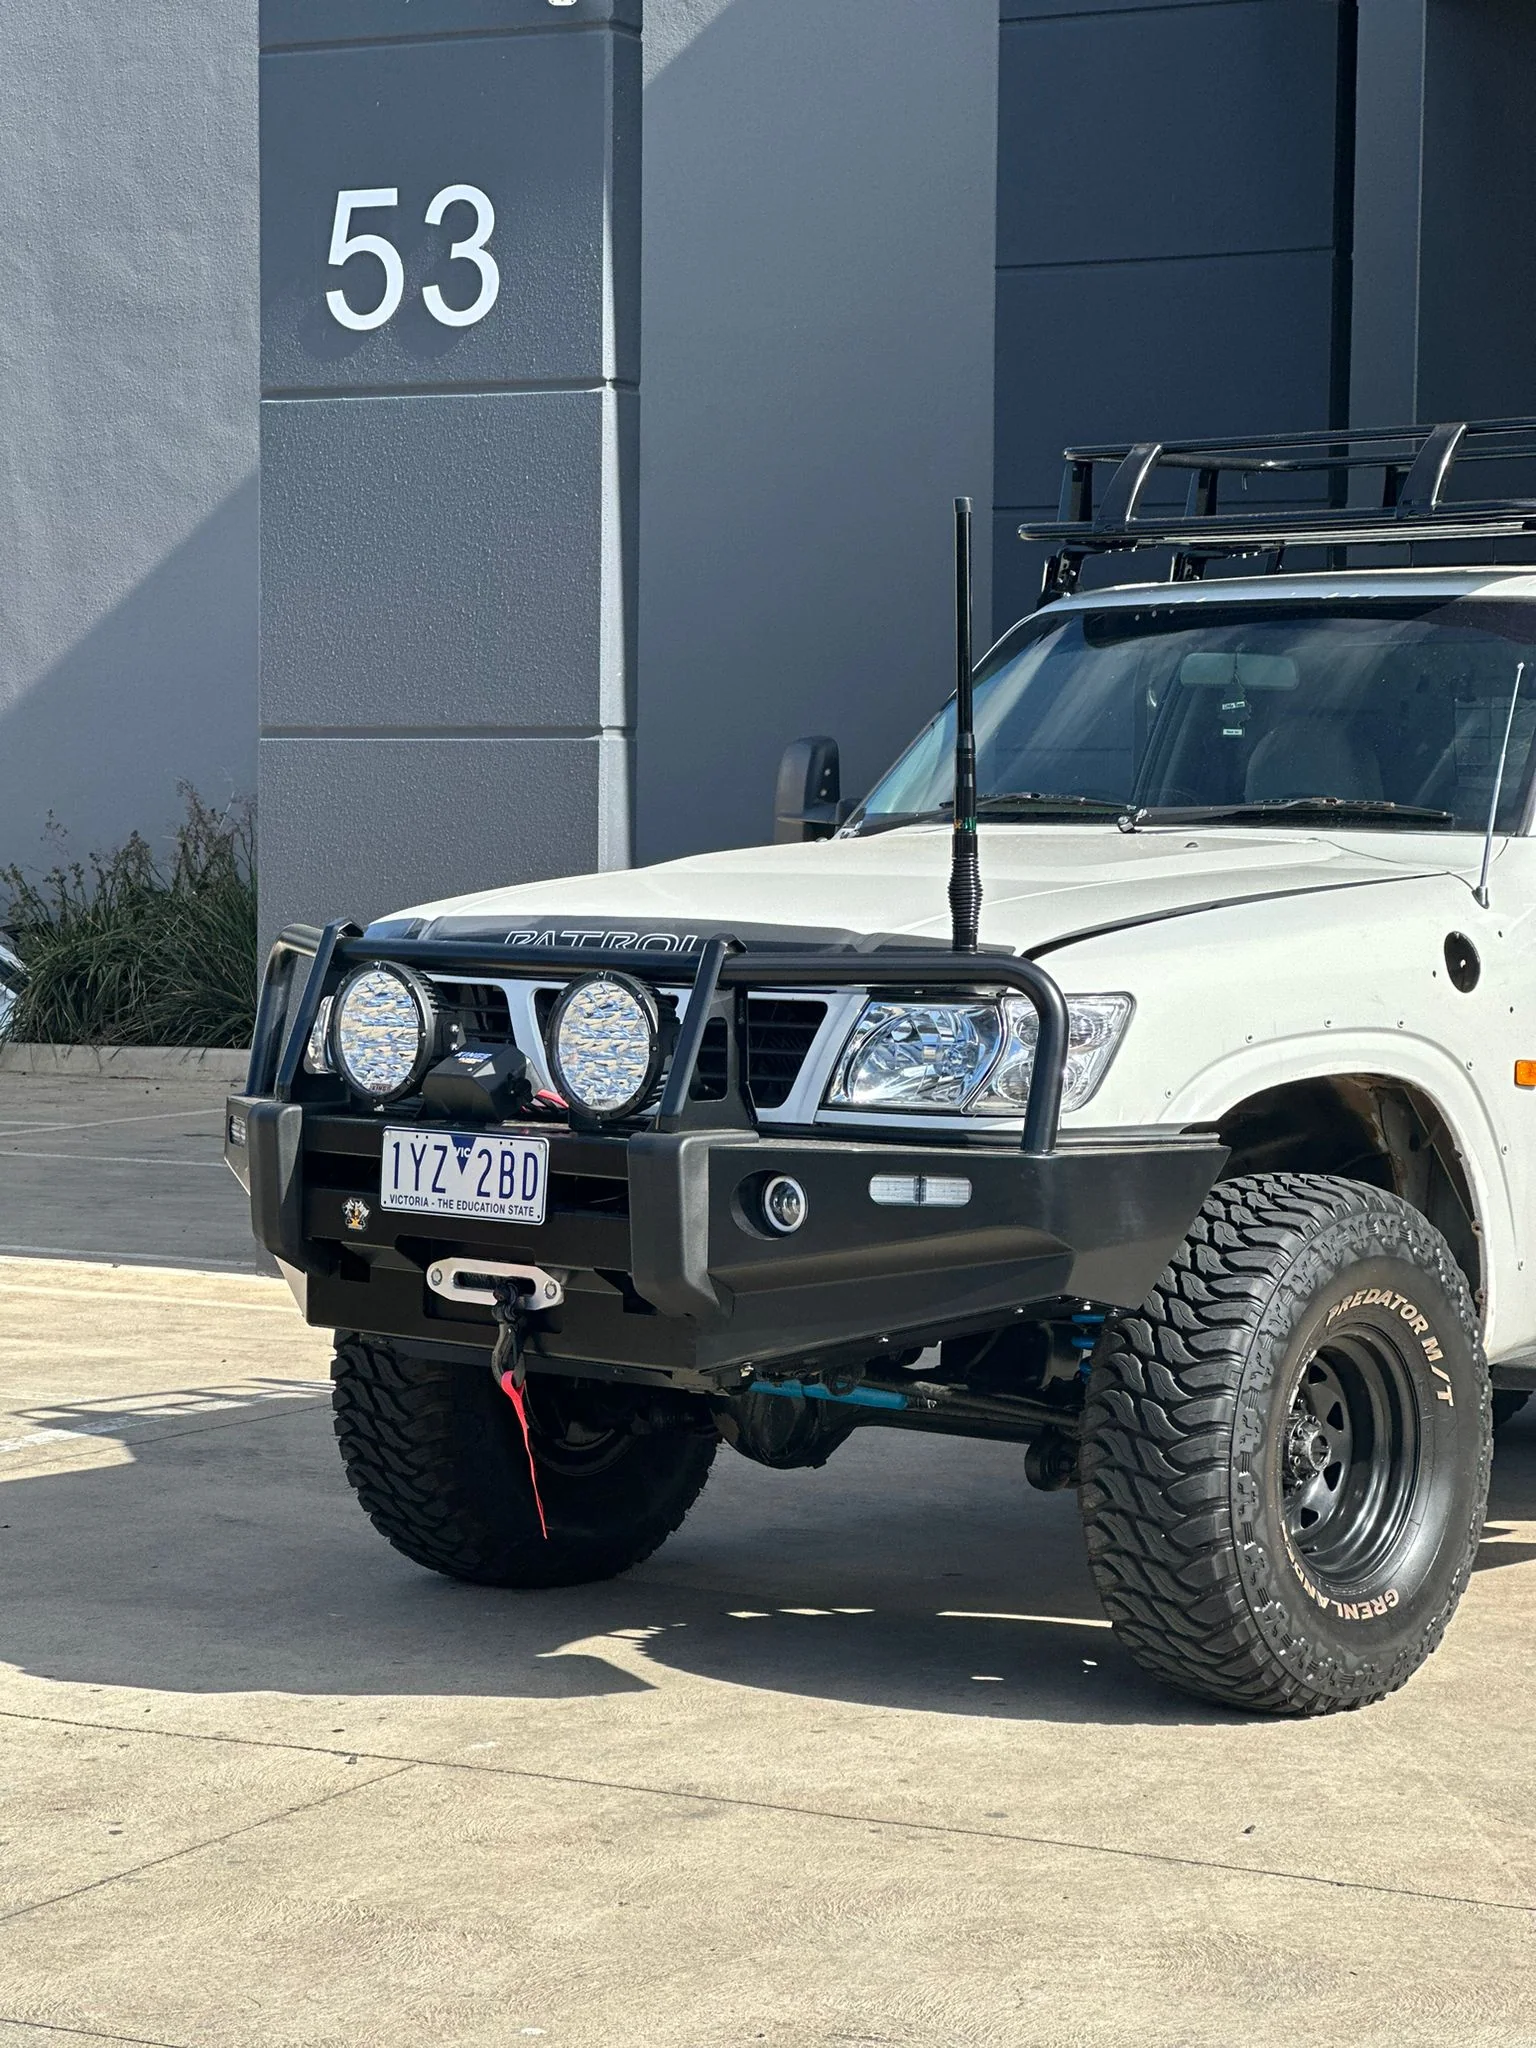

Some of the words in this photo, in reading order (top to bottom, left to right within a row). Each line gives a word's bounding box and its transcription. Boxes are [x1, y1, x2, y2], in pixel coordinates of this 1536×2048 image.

[326, 184, 500, 330] 53
[392, 1141, 448, 1194] 1YZ
[476, 1148, 539, 1201] 2BD
[455, 1146, 472, 1158] VIC
[389, 1194, 429, 1207] VICTORIA
[438, 1198, 454, 1209] THE
[457, 1200, 506, 1214] EDUCATION
[508, 1204, 534, 1217] STATE
[1325, 1288, 1429, 1336] PREDATOR
[1421, 1335, 1454, 1407] M/T
[1280, 1519, 1400, 1620] GRENLAND
